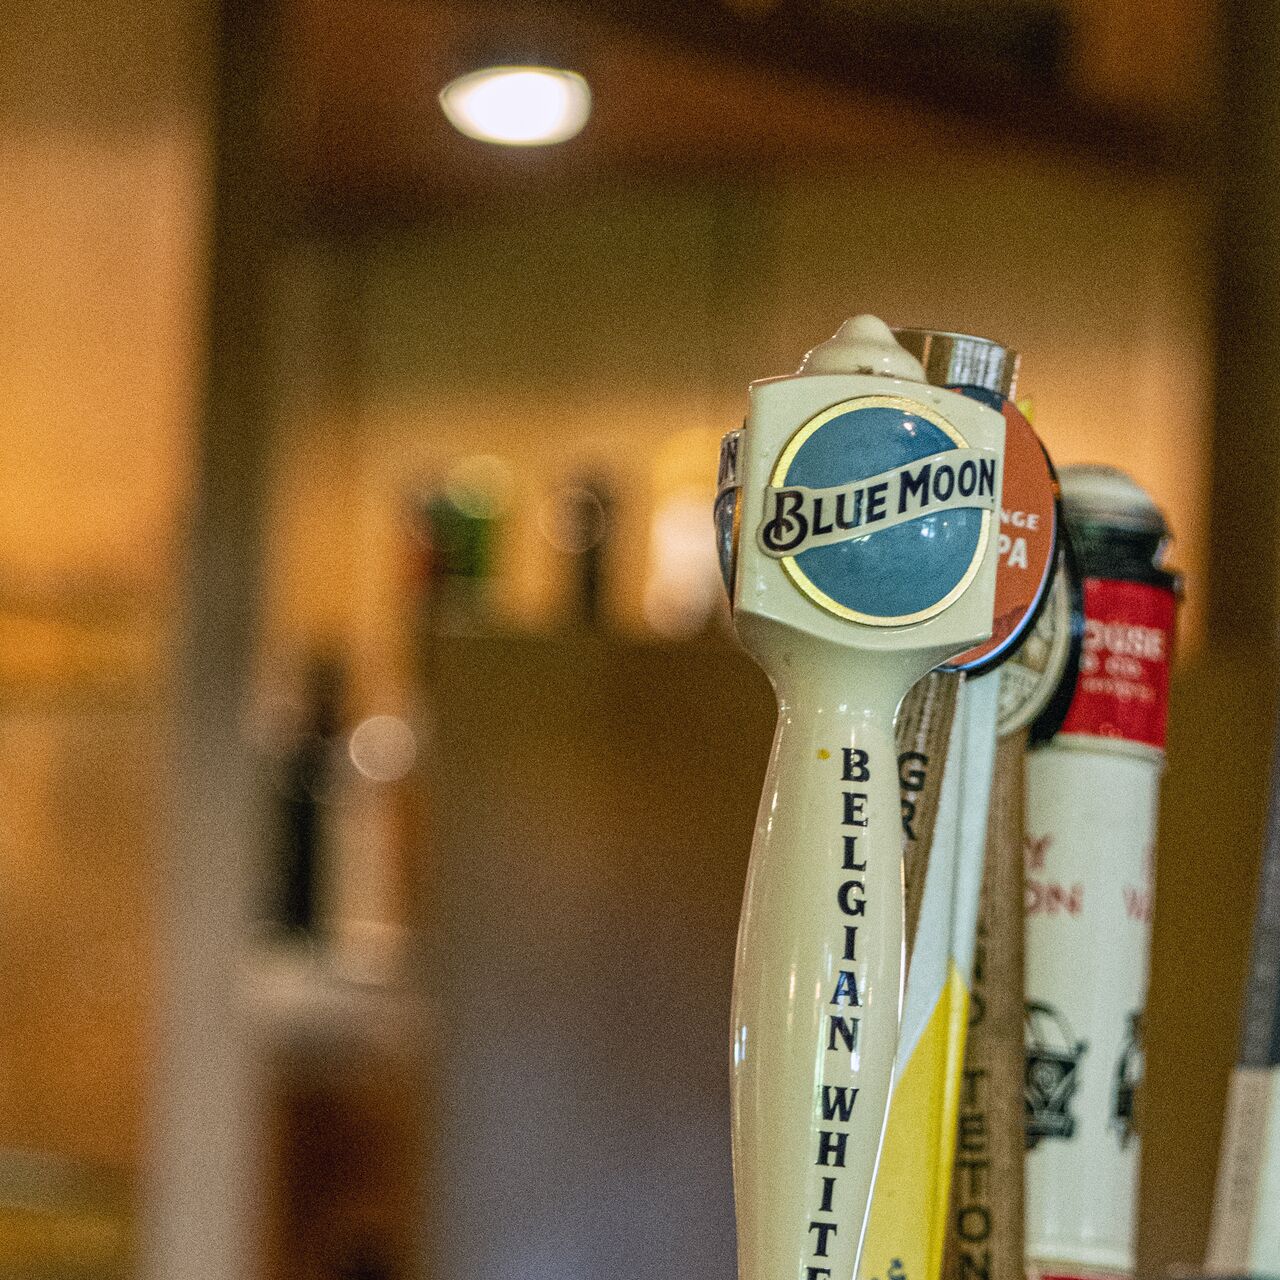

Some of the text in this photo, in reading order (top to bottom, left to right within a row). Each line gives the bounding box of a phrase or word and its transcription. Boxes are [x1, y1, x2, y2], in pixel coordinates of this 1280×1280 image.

[762, 458, 996, 552] BLUE MOON
[826, 748, 871, 1053] BELGIAN
